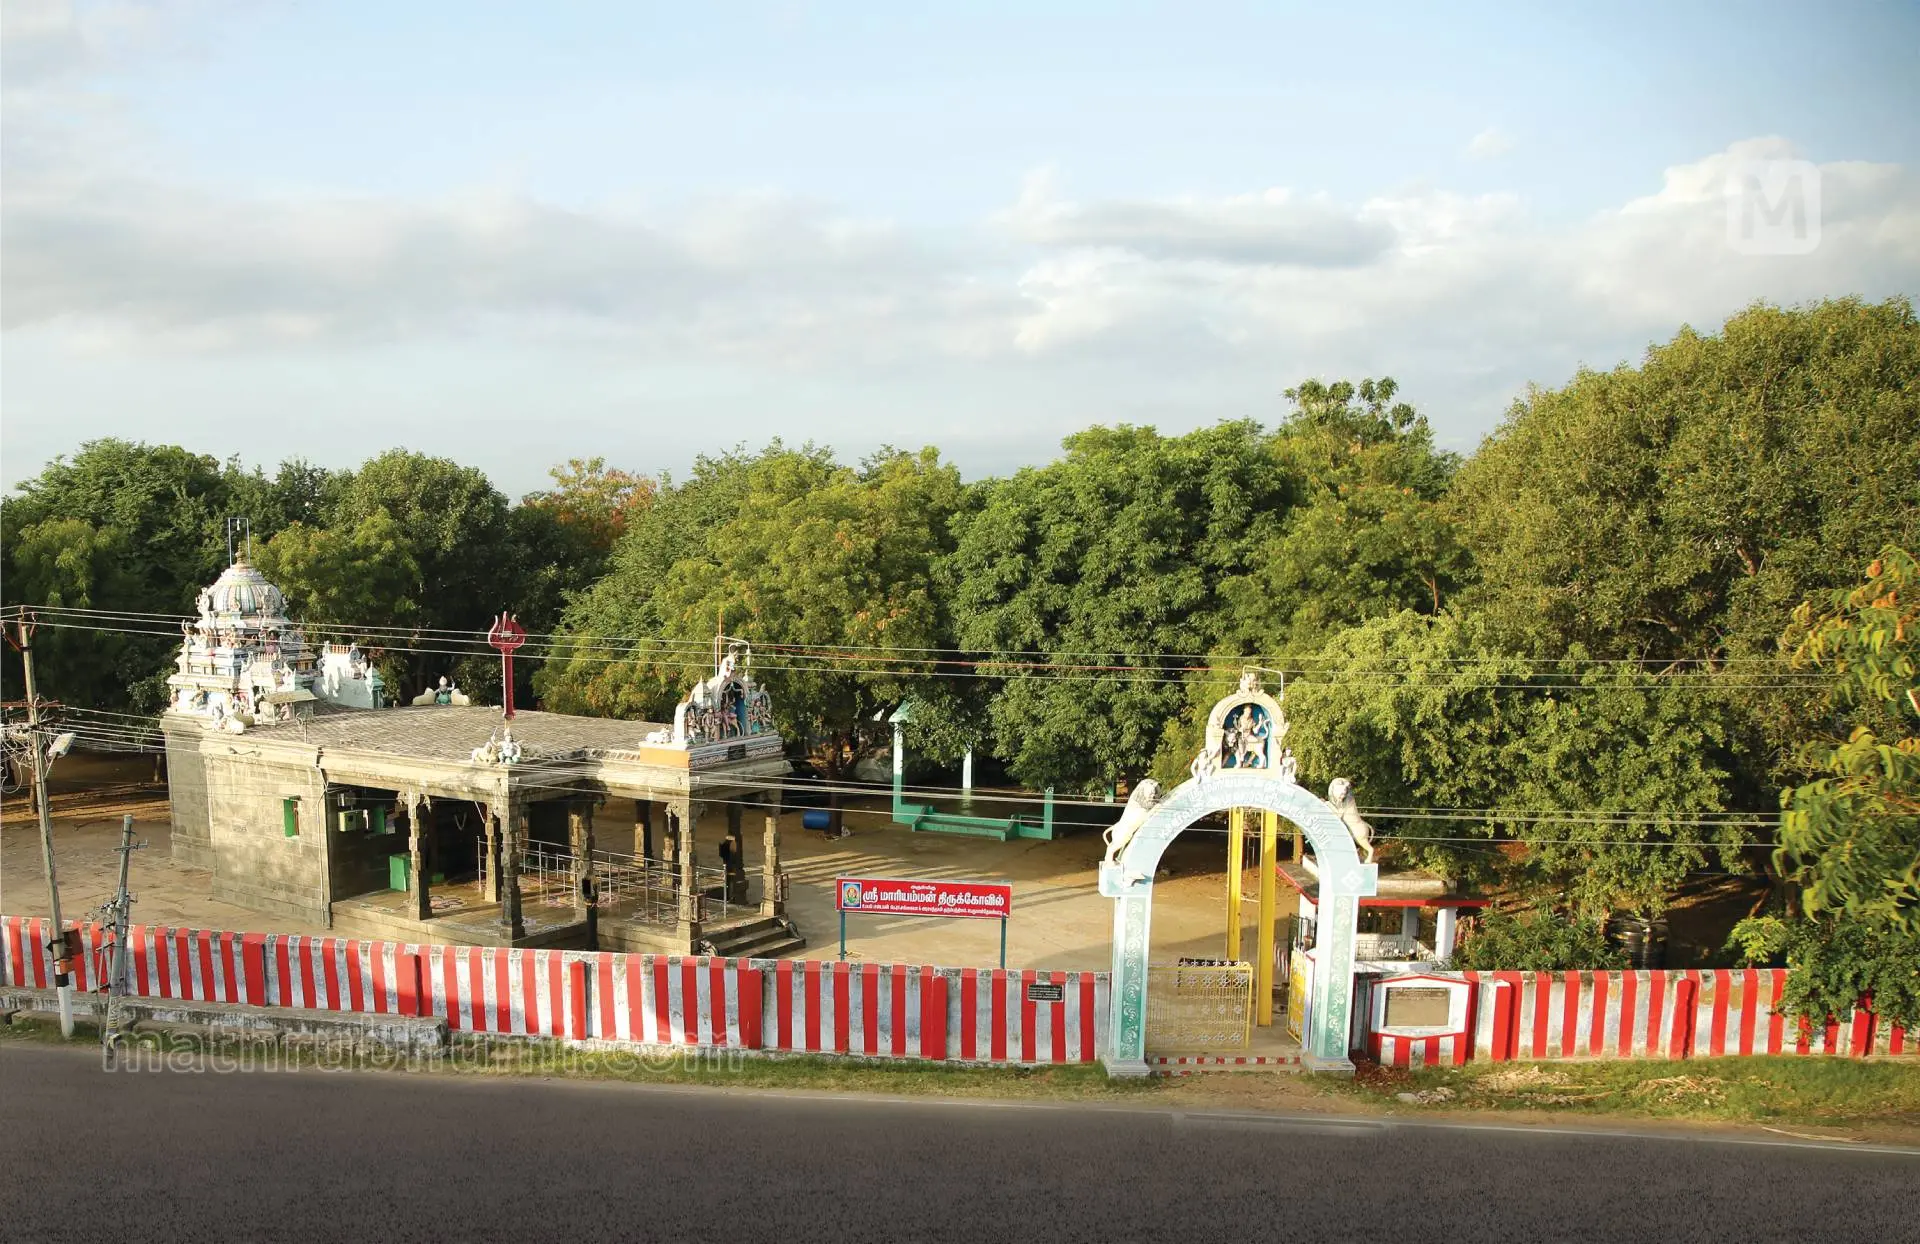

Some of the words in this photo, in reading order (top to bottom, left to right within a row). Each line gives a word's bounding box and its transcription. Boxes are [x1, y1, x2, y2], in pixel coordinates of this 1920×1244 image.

[862, 886, 879, 903] ஸ்ரீ
[880, 889, 937, 903] மாரியம்மன்
[938, 891, 1005, 907] திருக்கோவில்
